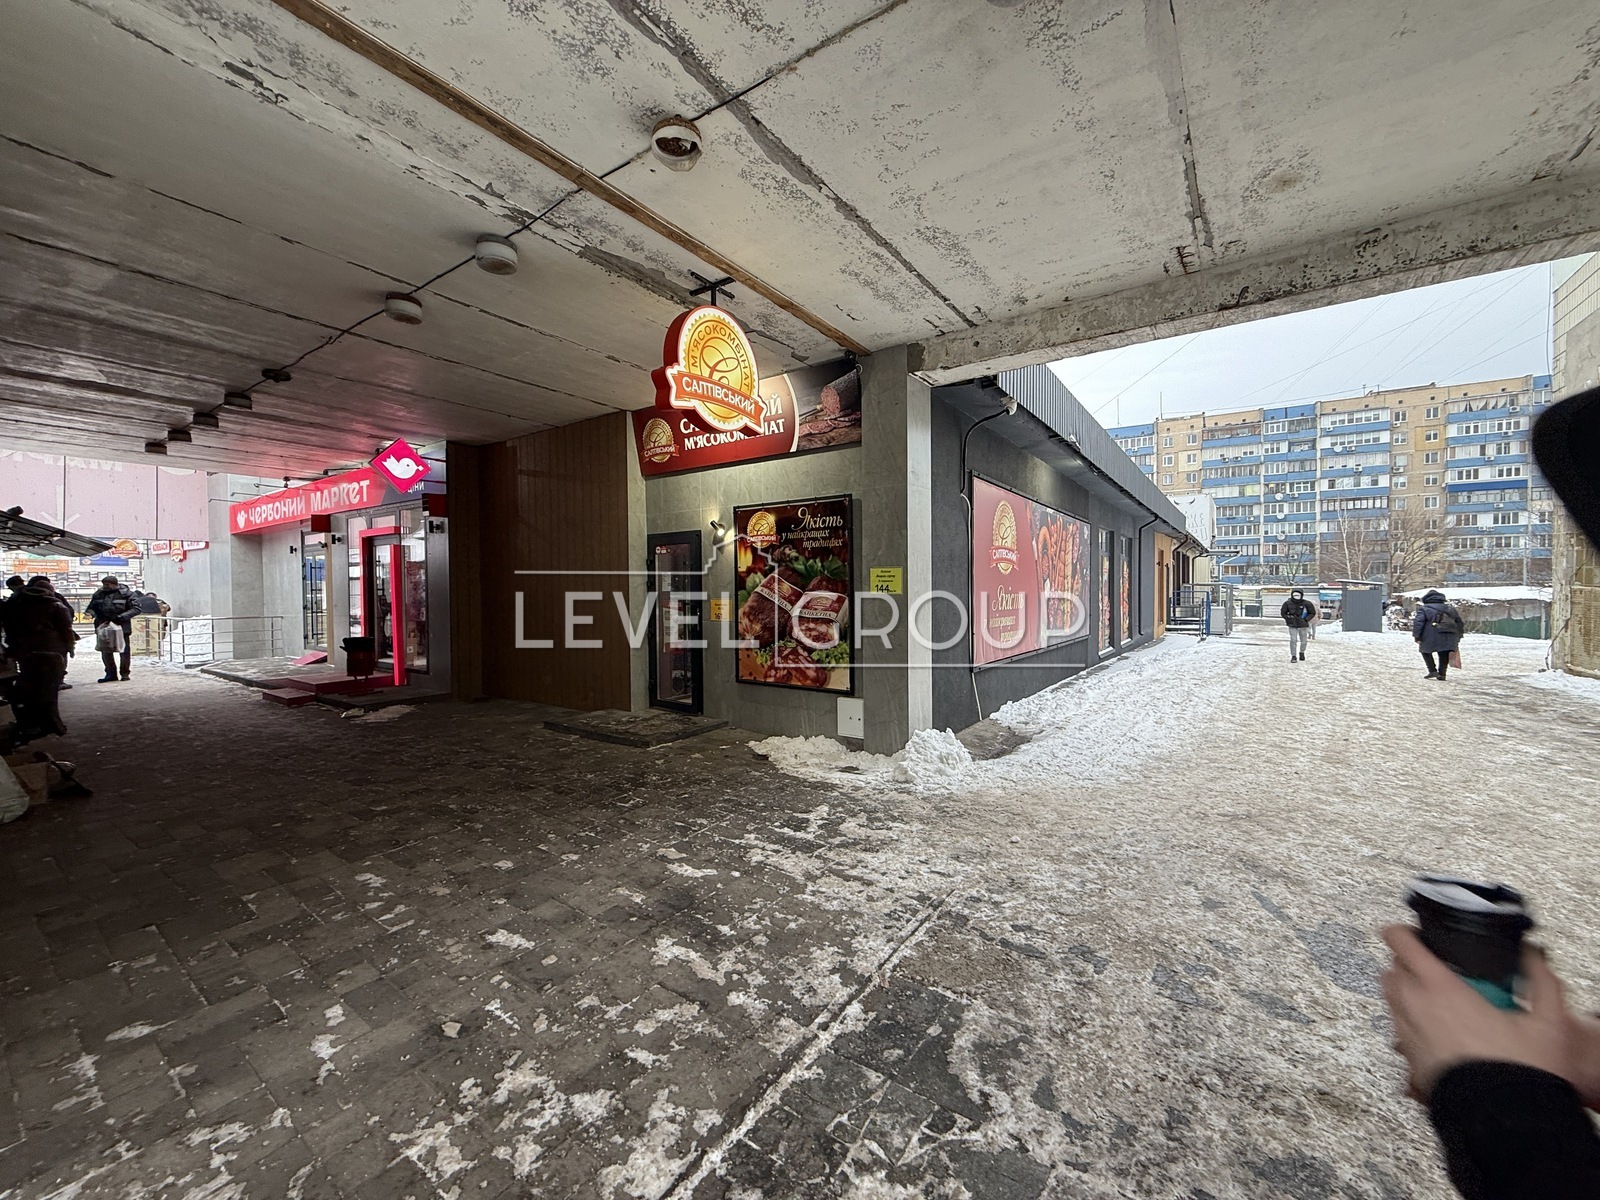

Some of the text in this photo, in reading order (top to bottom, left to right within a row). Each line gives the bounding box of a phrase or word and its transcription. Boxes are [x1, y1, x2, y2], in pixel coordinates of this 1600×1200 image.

[691, 324, 750, 392] М'ЯСОКОМБІНАТ
[681, 376, 756, 415] САЛТІВСЬКИЙ
[791, 506, 844, 531] Якість
[874, 584, 890, 594] 144
